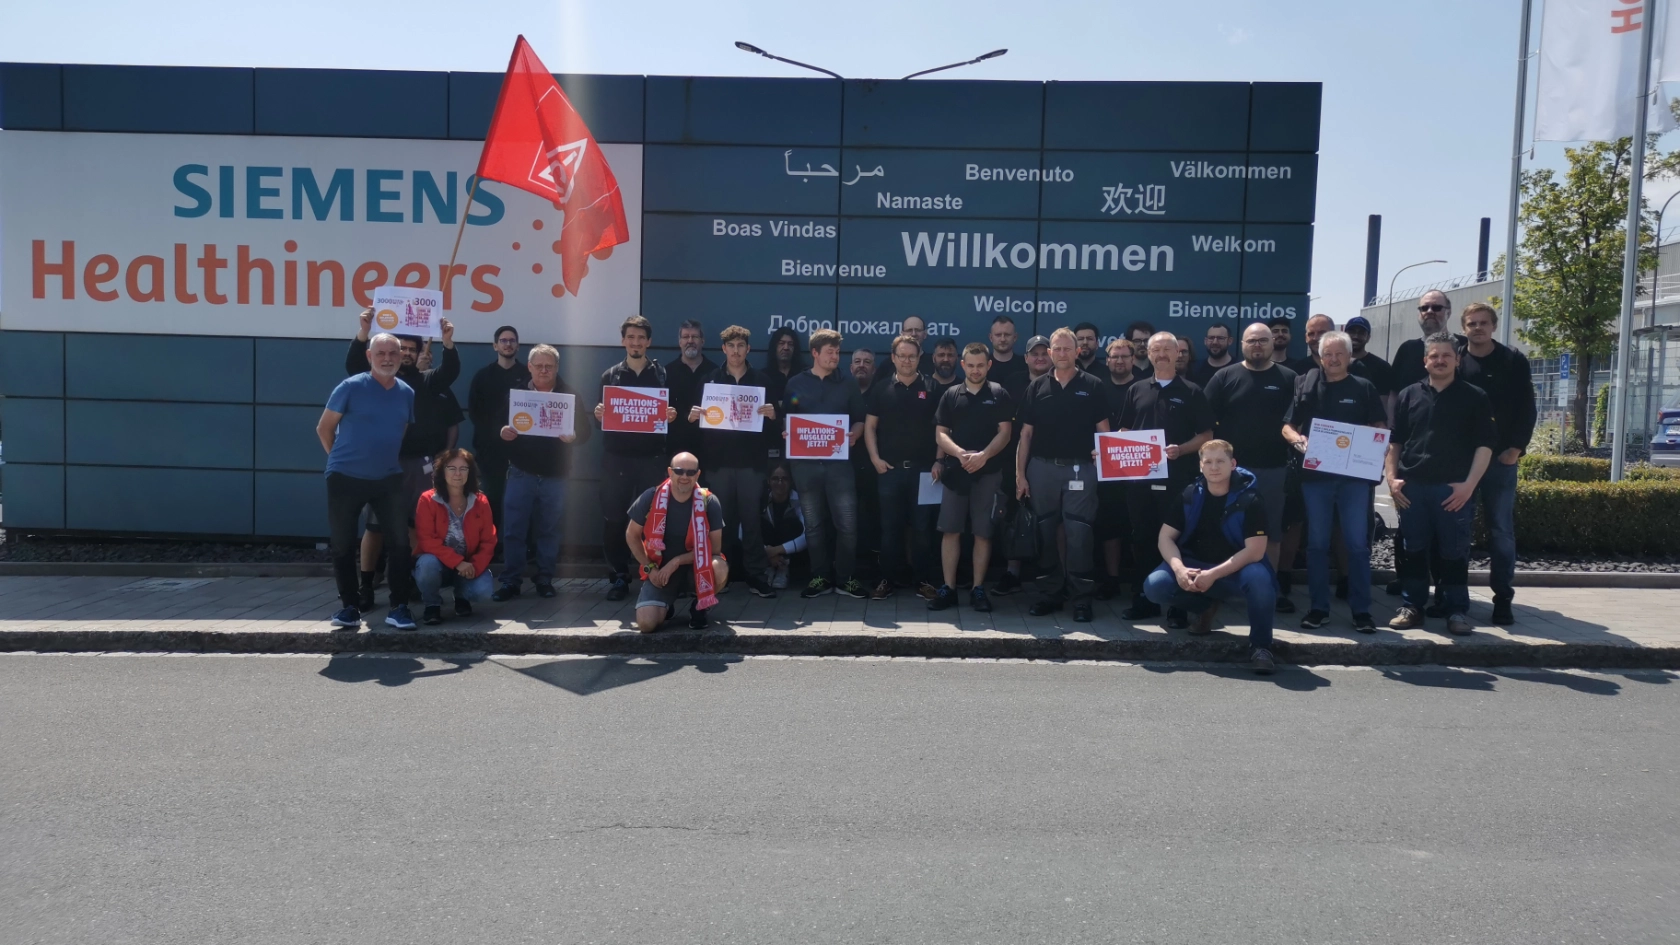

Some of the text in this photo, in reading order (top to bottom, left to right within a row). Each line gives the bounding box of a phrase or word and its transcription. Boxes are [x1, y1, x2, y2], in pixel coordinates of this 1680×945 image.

[965, 163, 1075, 182] Benvenuto
[1170, 160, 1291, 179] Välkommen
[172, 163, 506, 227] SIEMENS
[877, 192, 963, 210] Namaste
[1100, 183, 1166, 216] 欢迎
[713, 219, 837, 238] Boas Vindas
[1191, 234, 1276, 253] Welkom
[901, 231, 1175, 272] Willkommen
[781, 259, 887, 278] Bienvenue
[415, 298, 437, 307] 3000
[973, 296, 1068, 314] Welcome
[1168, 300, 1297, 319] Bienvenidos
[548, 401, 569, 410] 3000
[610, 397, 661, 408] INFLATIONS-
[739, 394, 759, 403] 3000
[613, 405, 658, 415] AUSGLEICH
[622, 413, 648, 423] JETZT!
[796, 427, 838, 435] INFLATIONS-
[807, 440, 828, 448] JETZT!
[1107, 445, 1153, 454] INFLATIONS-
[1111, 452, 1151, 461] AUSGLEICH
[1119, 459, 1143, 469] JETZT!
